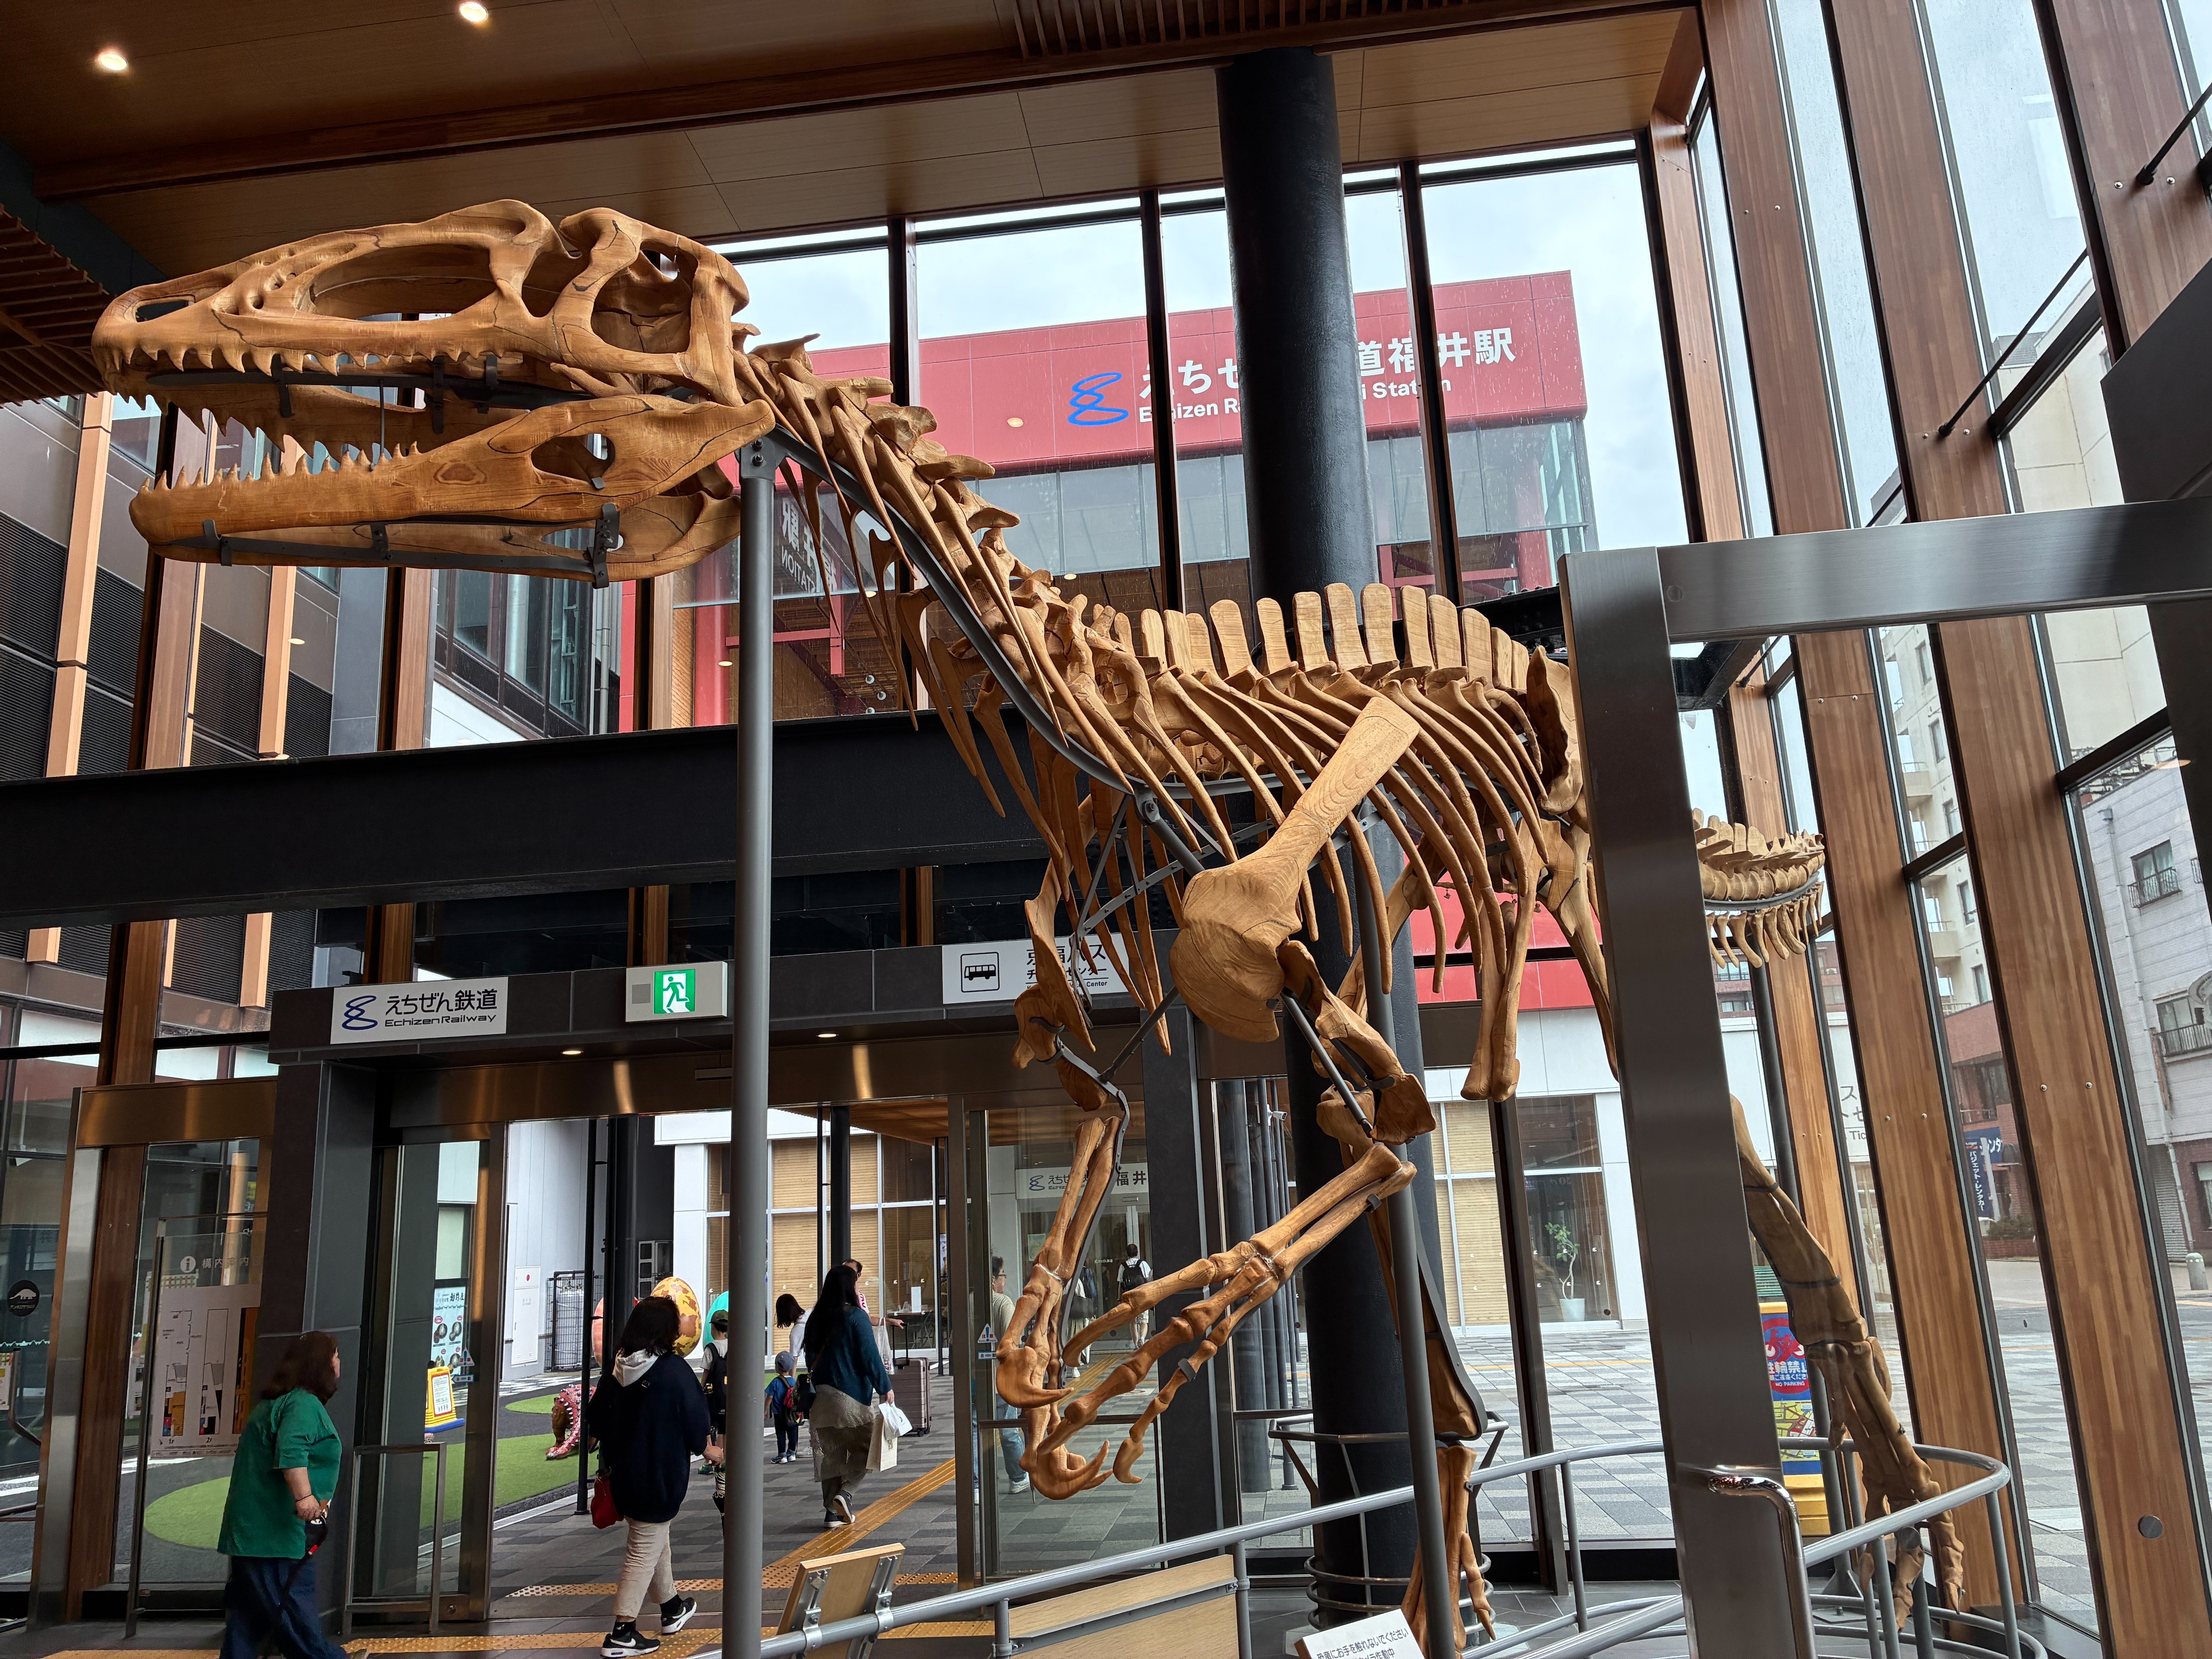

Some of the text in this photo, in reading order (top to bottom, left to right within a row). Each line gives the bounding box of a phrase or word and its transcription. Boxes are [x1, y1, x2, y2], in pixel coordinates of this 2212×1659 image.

[1139, 402, 1218, 422] Eizen
[1373, 378, 1451, 398] Statn
[385, 989, 497, 1015] えちぜん鉄道
[385, 1015, 496, 1027] Echizen Railway
